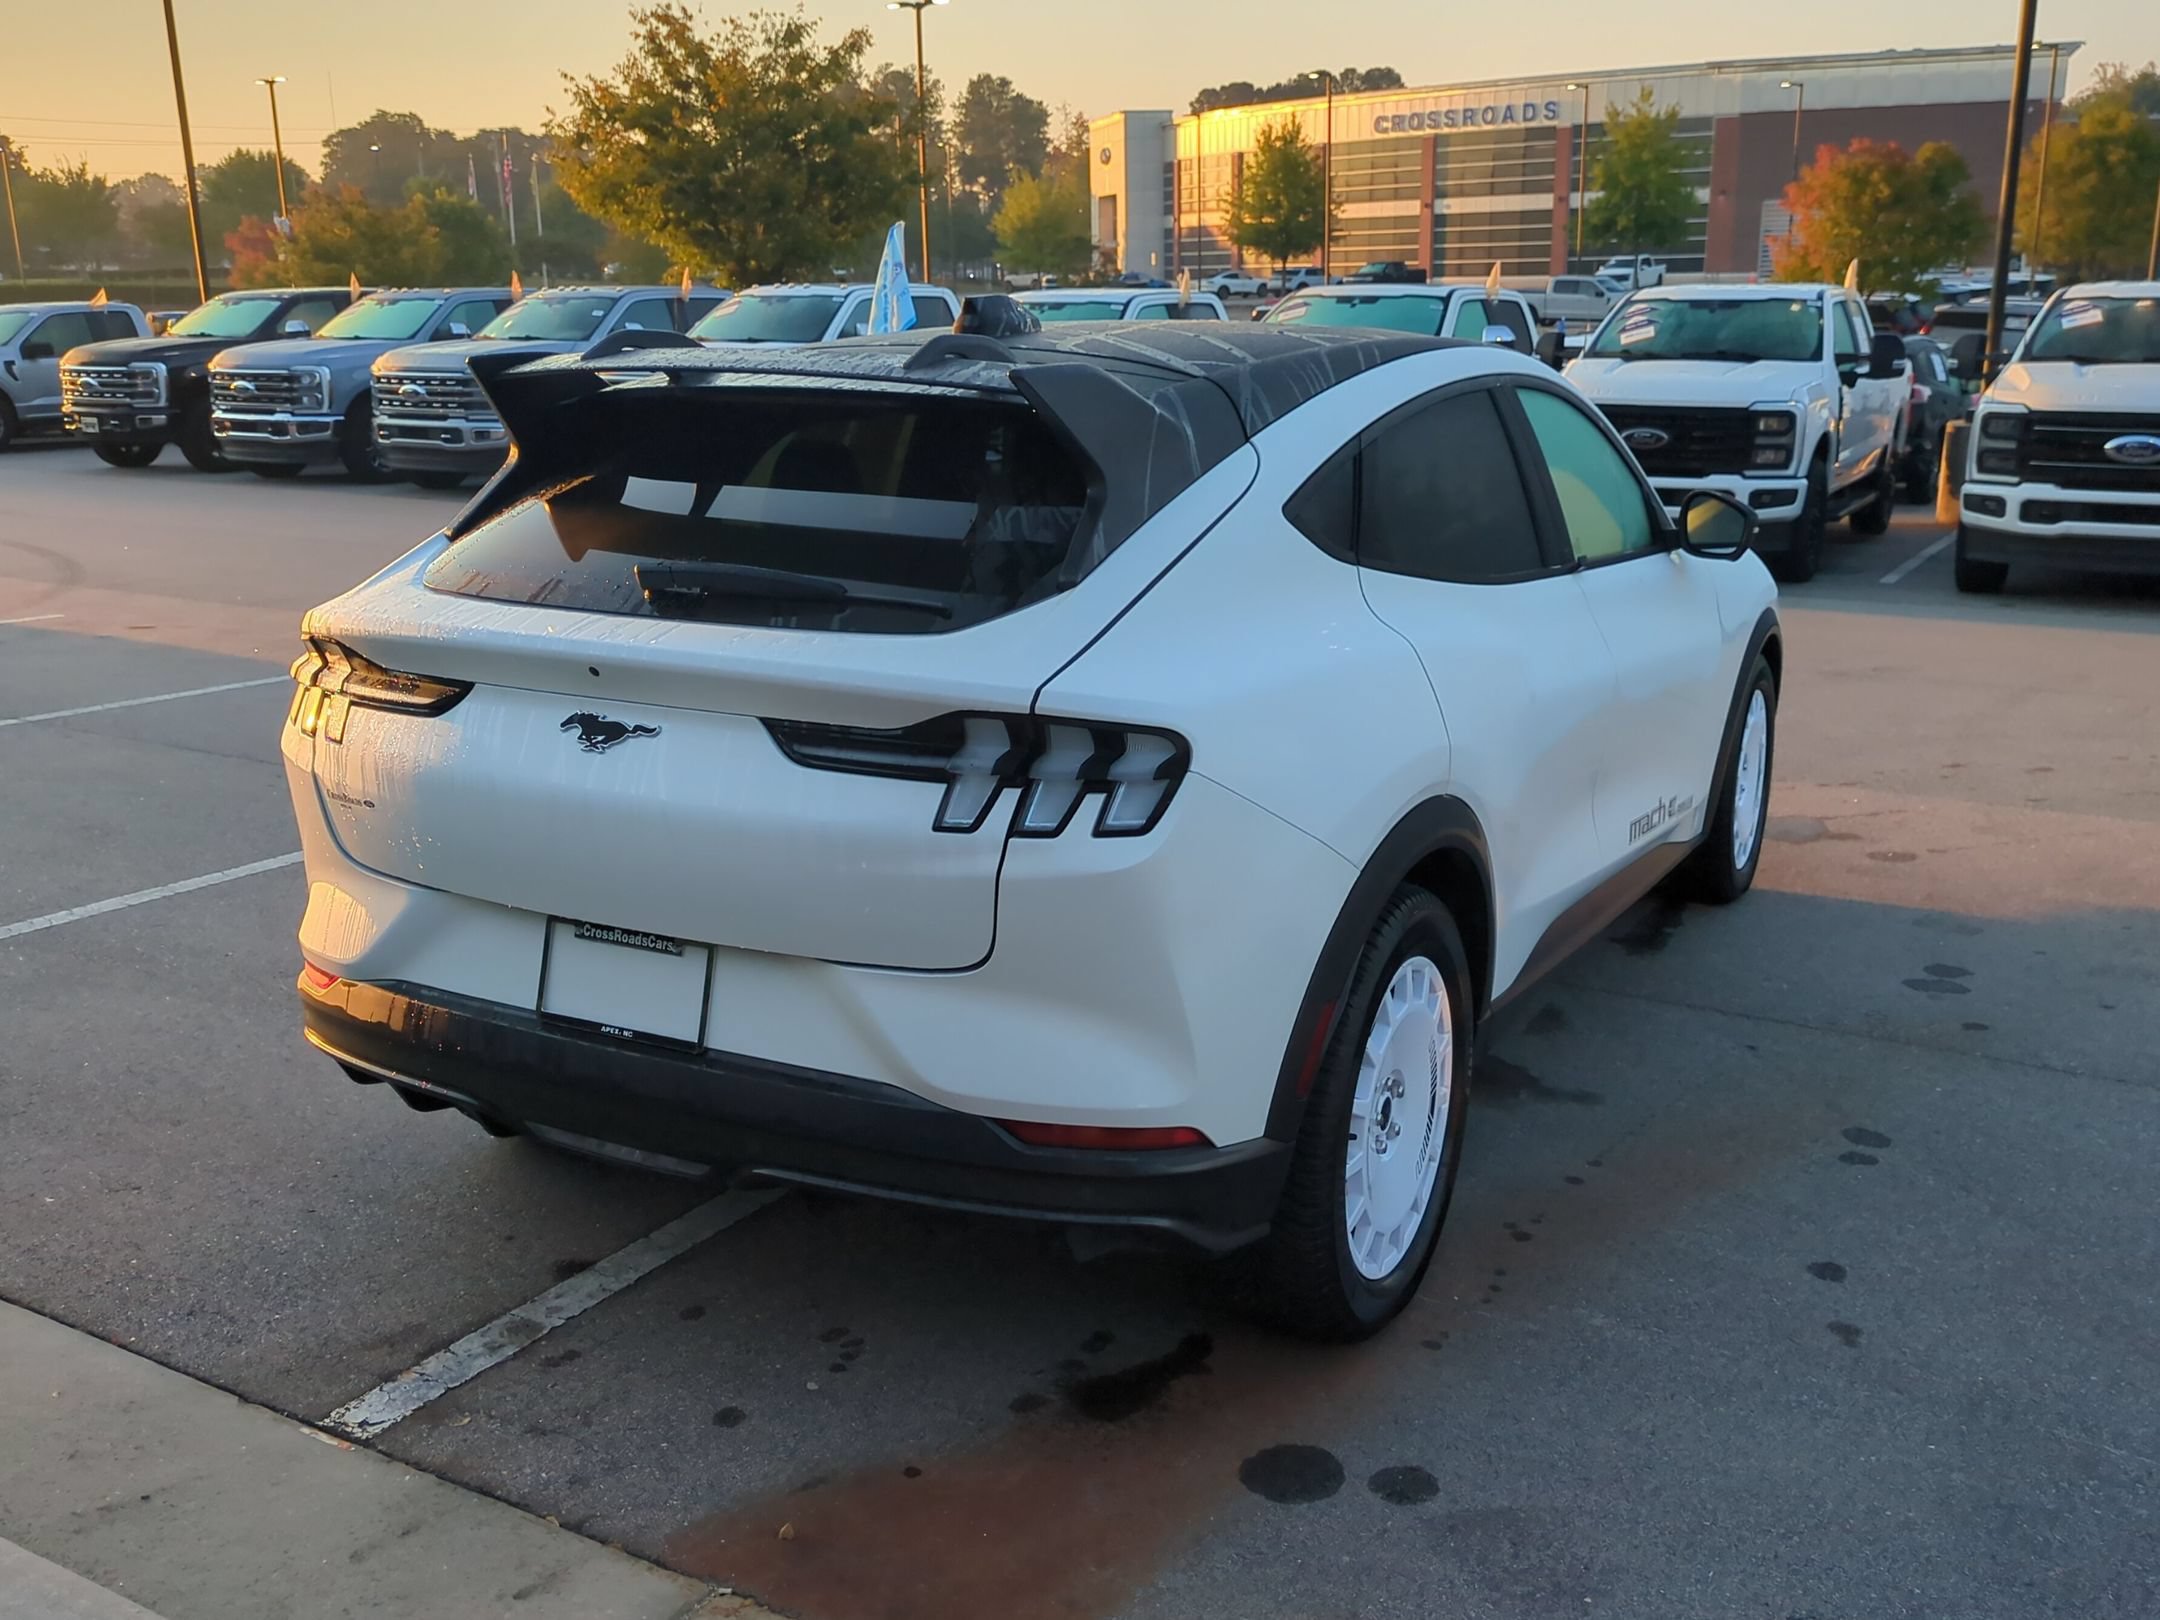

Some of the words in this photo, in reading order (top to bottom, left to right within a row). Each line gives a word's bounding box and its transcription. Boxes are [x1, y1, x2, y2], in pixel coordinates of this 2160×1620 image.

[1374, 101, 1559, 134] CROSSROADS
[583, 924, 673, 951] CrossRoadsCars
[622, 1030, 633, 1038] NC
